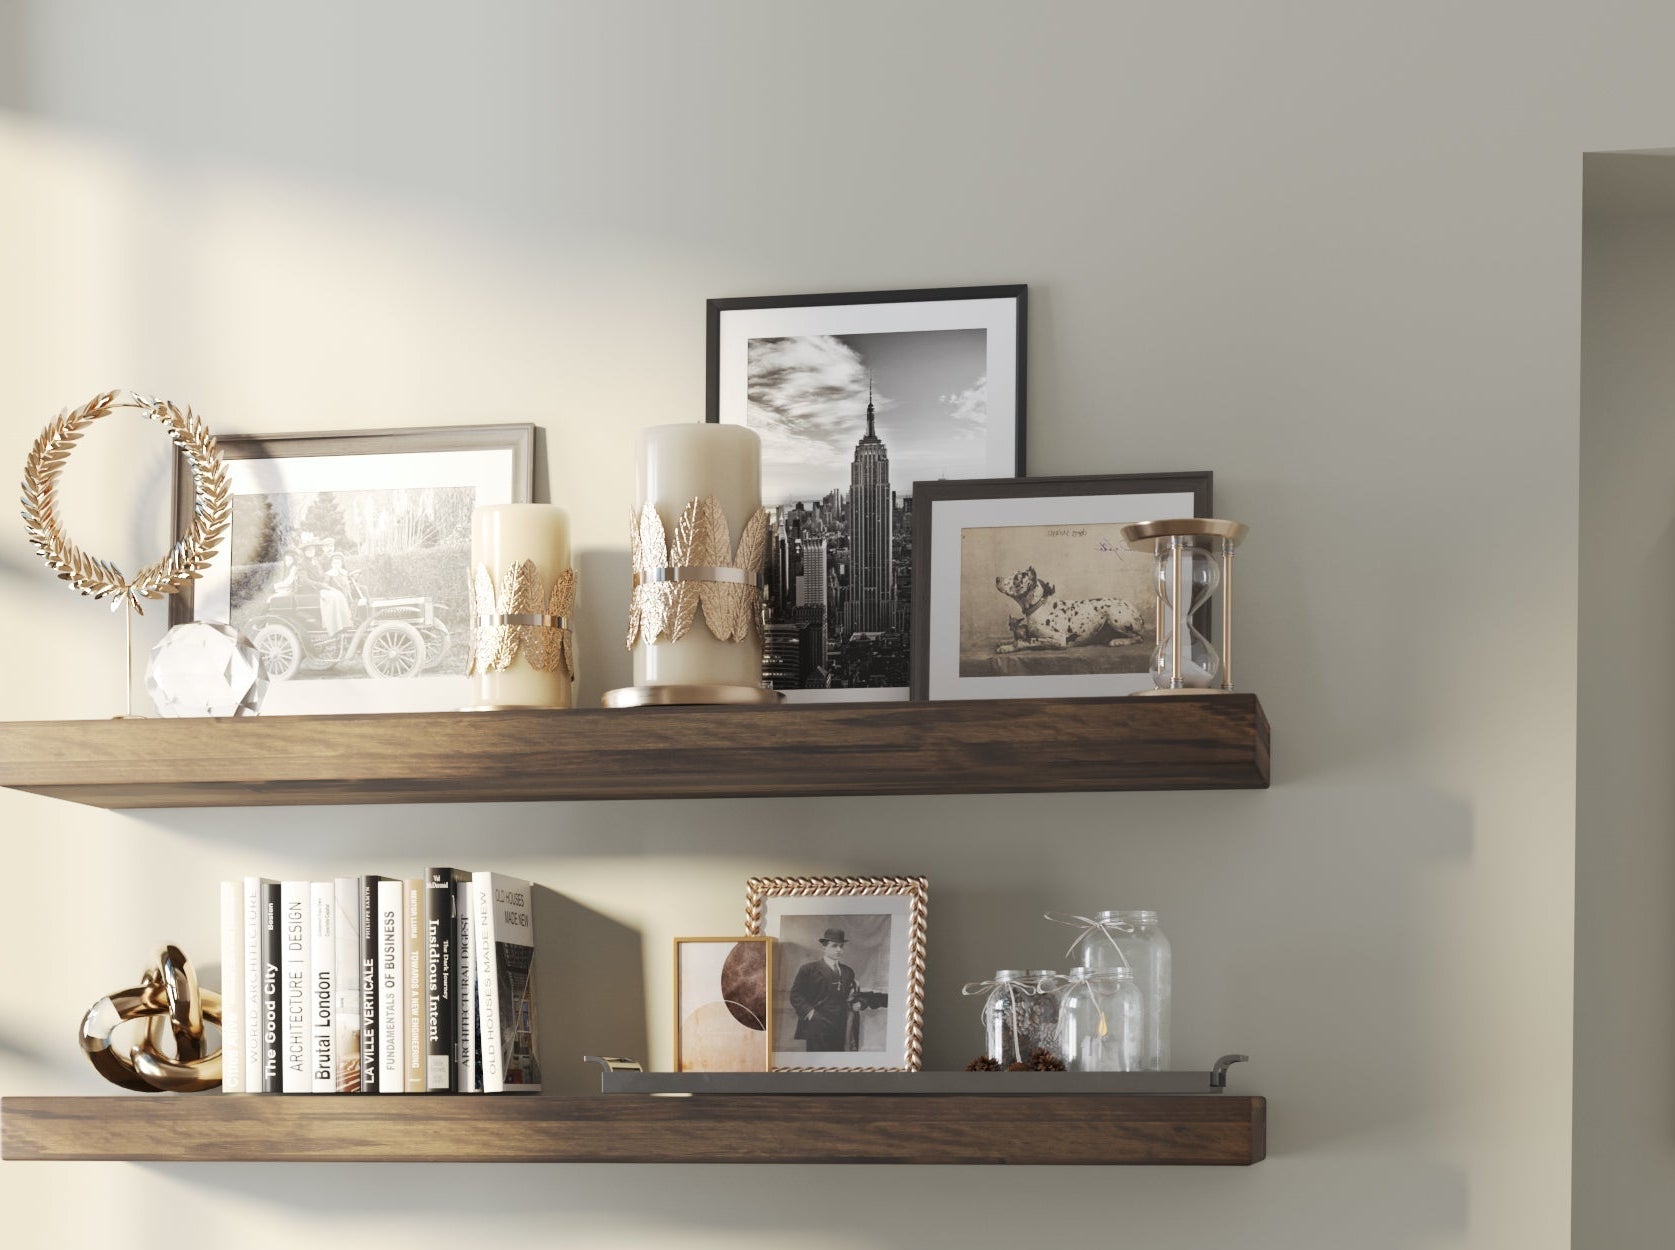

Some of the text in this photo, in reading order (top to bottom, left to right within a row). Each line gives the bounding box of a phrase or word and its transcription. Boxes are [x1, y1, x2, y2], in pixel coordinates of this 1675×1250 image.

[249, 889, 260, 1065] WORLD ARCHITECTURE
[288, 901, 303, 951] DESIGN
[411, 951, 419, 989] TOWARDS
[429, 919, 440, 1042] Insidious Intent
[479, 892, 496, 1075] OLD HOUSES MADE NEW
[265, 962, 279, 1080] The Good City
[288, 971, 304, 1072] ARCHITECTURE
[314, 971, 331, 1080] Brutal London
[362, 958, 374, 1085] LA VILLE VERTICALE
[384, 911, 396, 1071] FUNDAMENTALS OF BUSINESS
[411, 998, 419, 1016] NEW
[411, 1018, 419, 1069] ENGINEERING
[461, 914, 470, 1067] ARCHITECTURAL DIGEST
